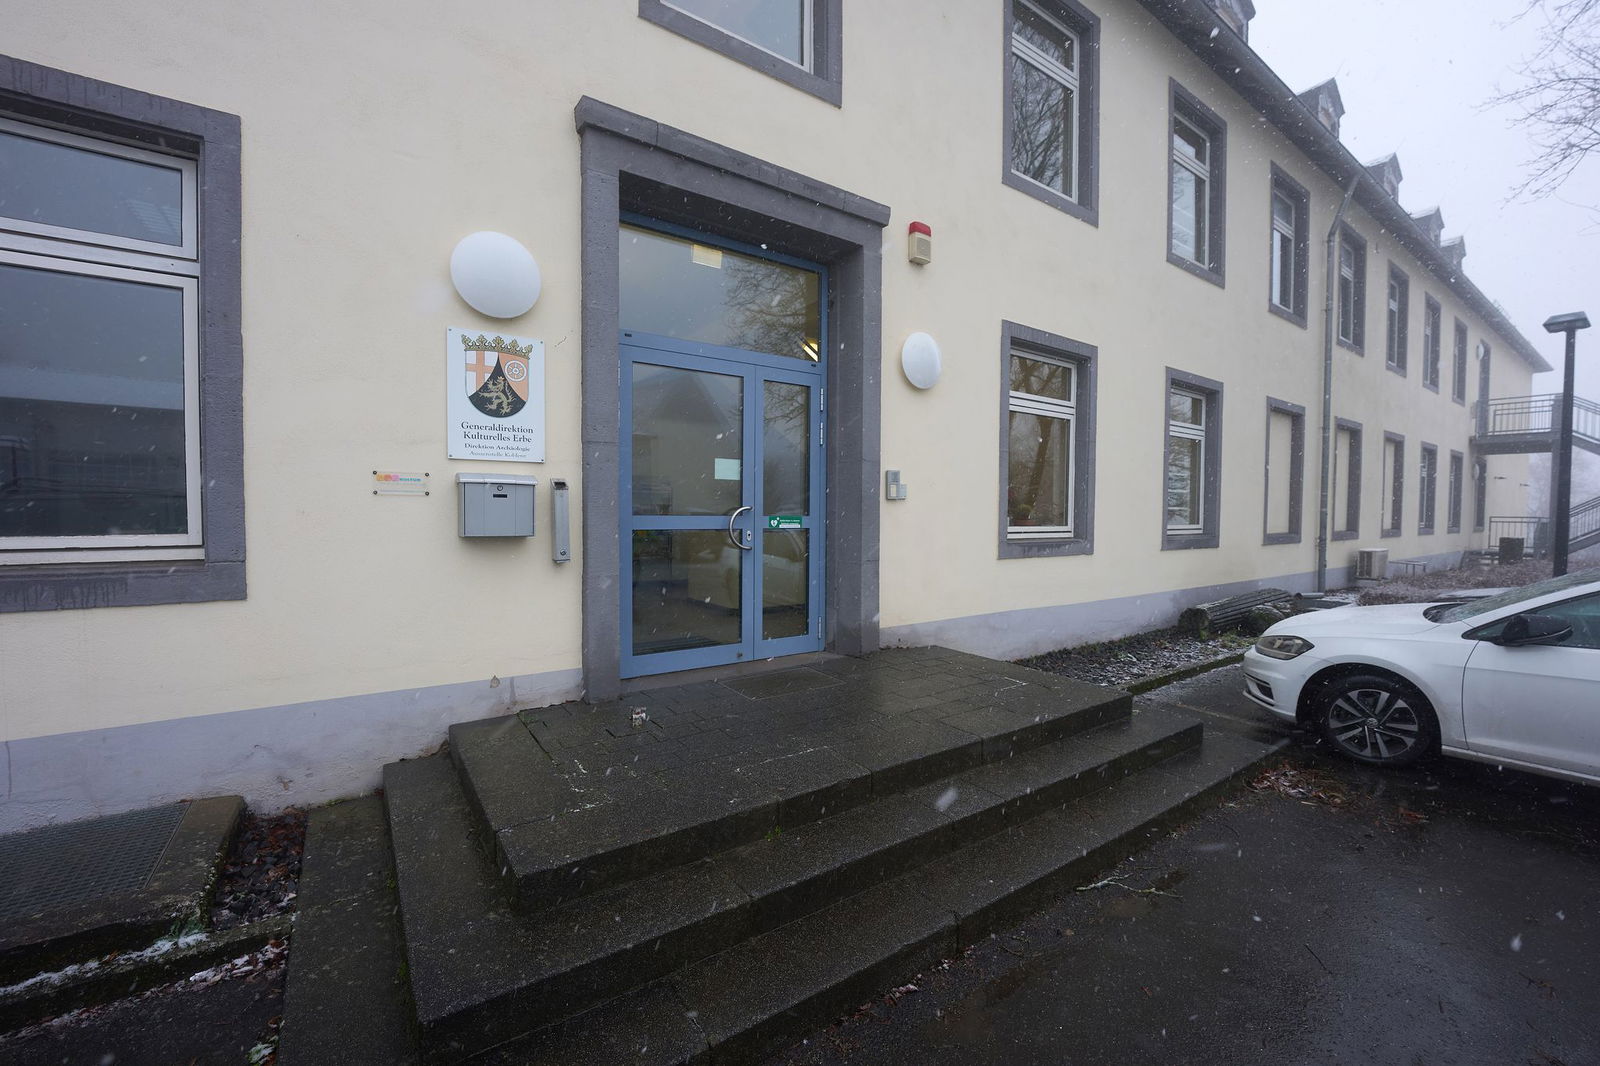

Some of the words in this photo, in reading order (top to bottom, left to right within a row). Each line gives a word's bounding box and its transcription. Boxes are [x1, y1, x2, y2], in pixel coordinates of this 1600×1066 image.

[461, 421, 534, 434] Generaldirektion
[463, 431, 511, 441] Kulturelles
[513, 434, 532, 443] Erbe
[496, 444, 530, 453] Archäologie
